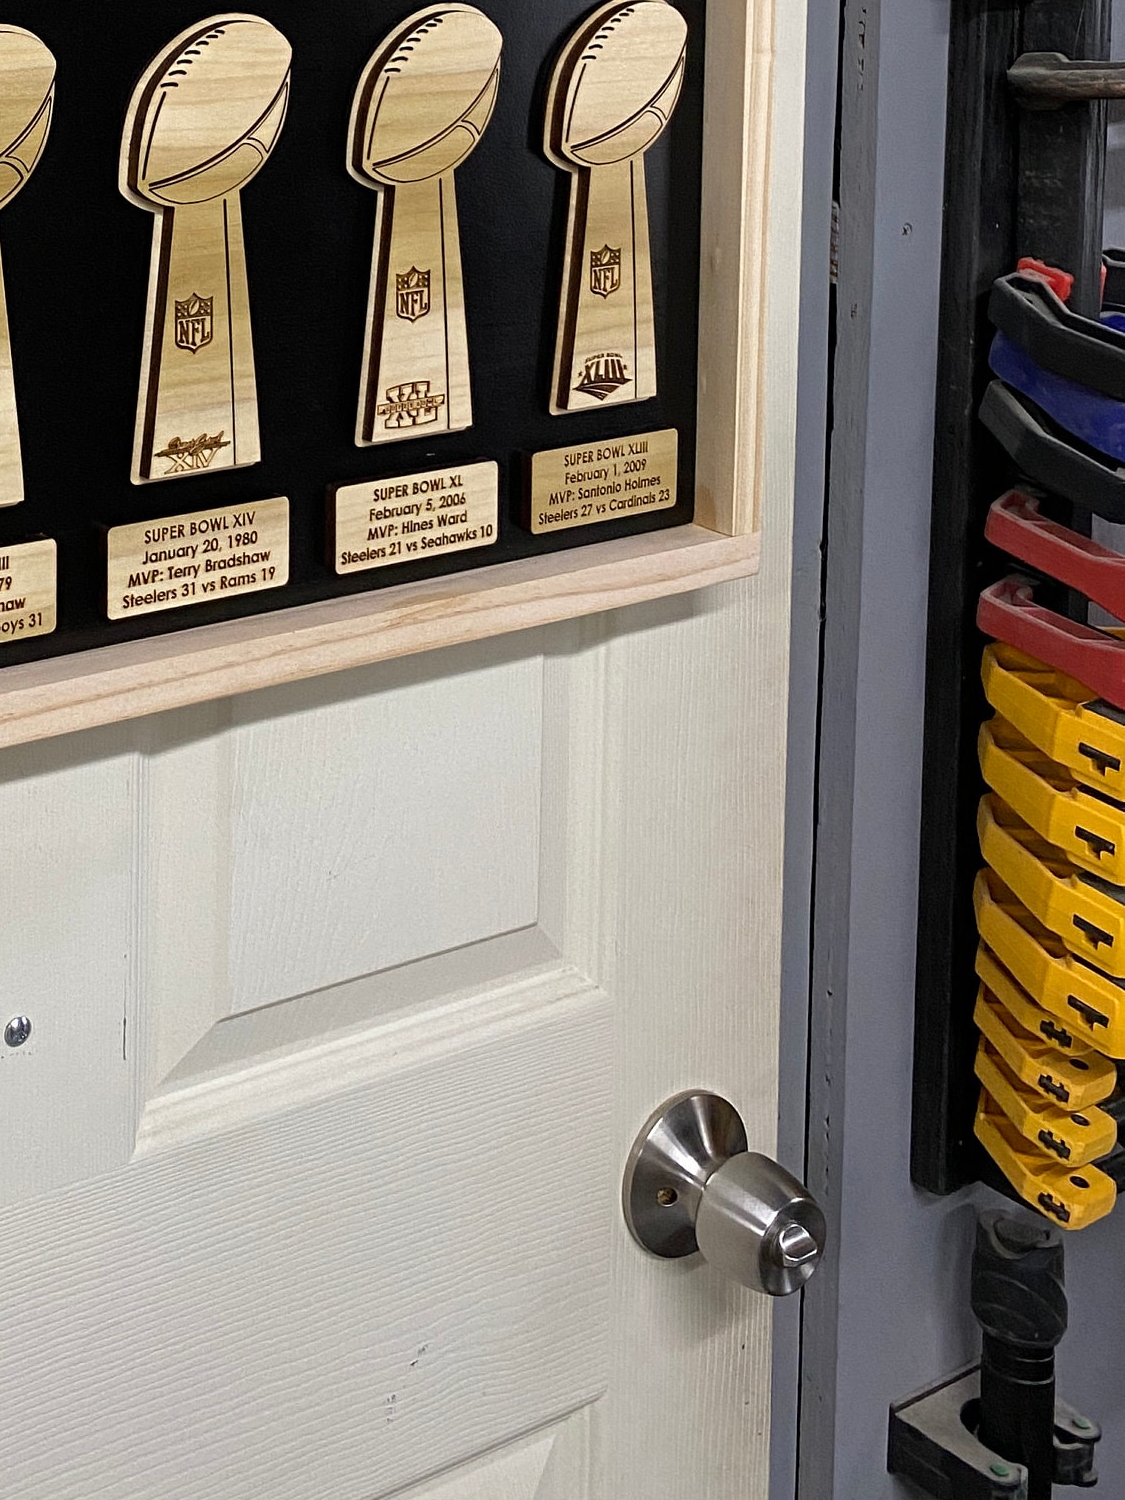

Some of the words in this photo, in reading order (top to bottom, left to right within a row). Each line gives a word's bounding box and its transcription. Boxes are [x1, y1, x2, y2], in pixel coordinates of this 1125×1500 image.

[593, 267, 618, 292] NFL
[399, 290, 427, 316] NFL
[179, 318, 210, 346] NFL
[579, 359, 626, 385] XLIII
[164, 448, 220, 475] XIV
[564, 451, 593, 467] SUPER
[597, 447, 625, 461] BOWL
[565, 468, 608, 485] February
[613, 465, 620, 476] 1,
[624, 459, 646, 474] 2009
[374, 484, 408, 502] SUPER
[413, 479, 446, 495] BOWL
[449, 475, 463, 488] XL
[549, 492, 575, 506] MVP:
[578, 483, 621, 500] Santonio
[625, 476, 660, 490] Holmes
[370, 502, 422, 521] February
[426, 499, 436, 511] 5,
[439, 493, 465, 508] 2006
[539, 508, 578, 525] Steelers
[581, 504, 593, 517] 27
[596, 504, 606, 514] vs
[609, 493, 655, 511] Cardinals
[659, 489, 670, 502] 23
[145, 525, 186, 544] SUPER
[190, 516, 228, 535] BOWL
[233, 512, 255, 528] XIV
[367, 525, 398, 541] MVP:
[402, 518, 433, 534] Hines
[437, 510, 467, 526] Ward
[143, 545, 198, 565] January
[203, 538, 222, 554] 20,
[228, 531, 258, 549] 1980
[341, 547, 386, 565] Steelers
[389, 541, 401, 555] 21
[406, 541, 417, 552] vs
[421, 529, 477, 549] Seahawks
[480, 524, 492, 538] 10
[128, 570, 163, 588] MVP:
[168, 563, 200, 580] Terry
[206, 551, 271, 573] Bradshaw
[122, 588, 177, 609] Steelers
[182, 582, 195, 596] 31
[202, 580, 215, 593] vs
[221, 573, 256, 590] Rams
[261, 566, 275, 580] 19
[29, 612, 42, 627] 31
